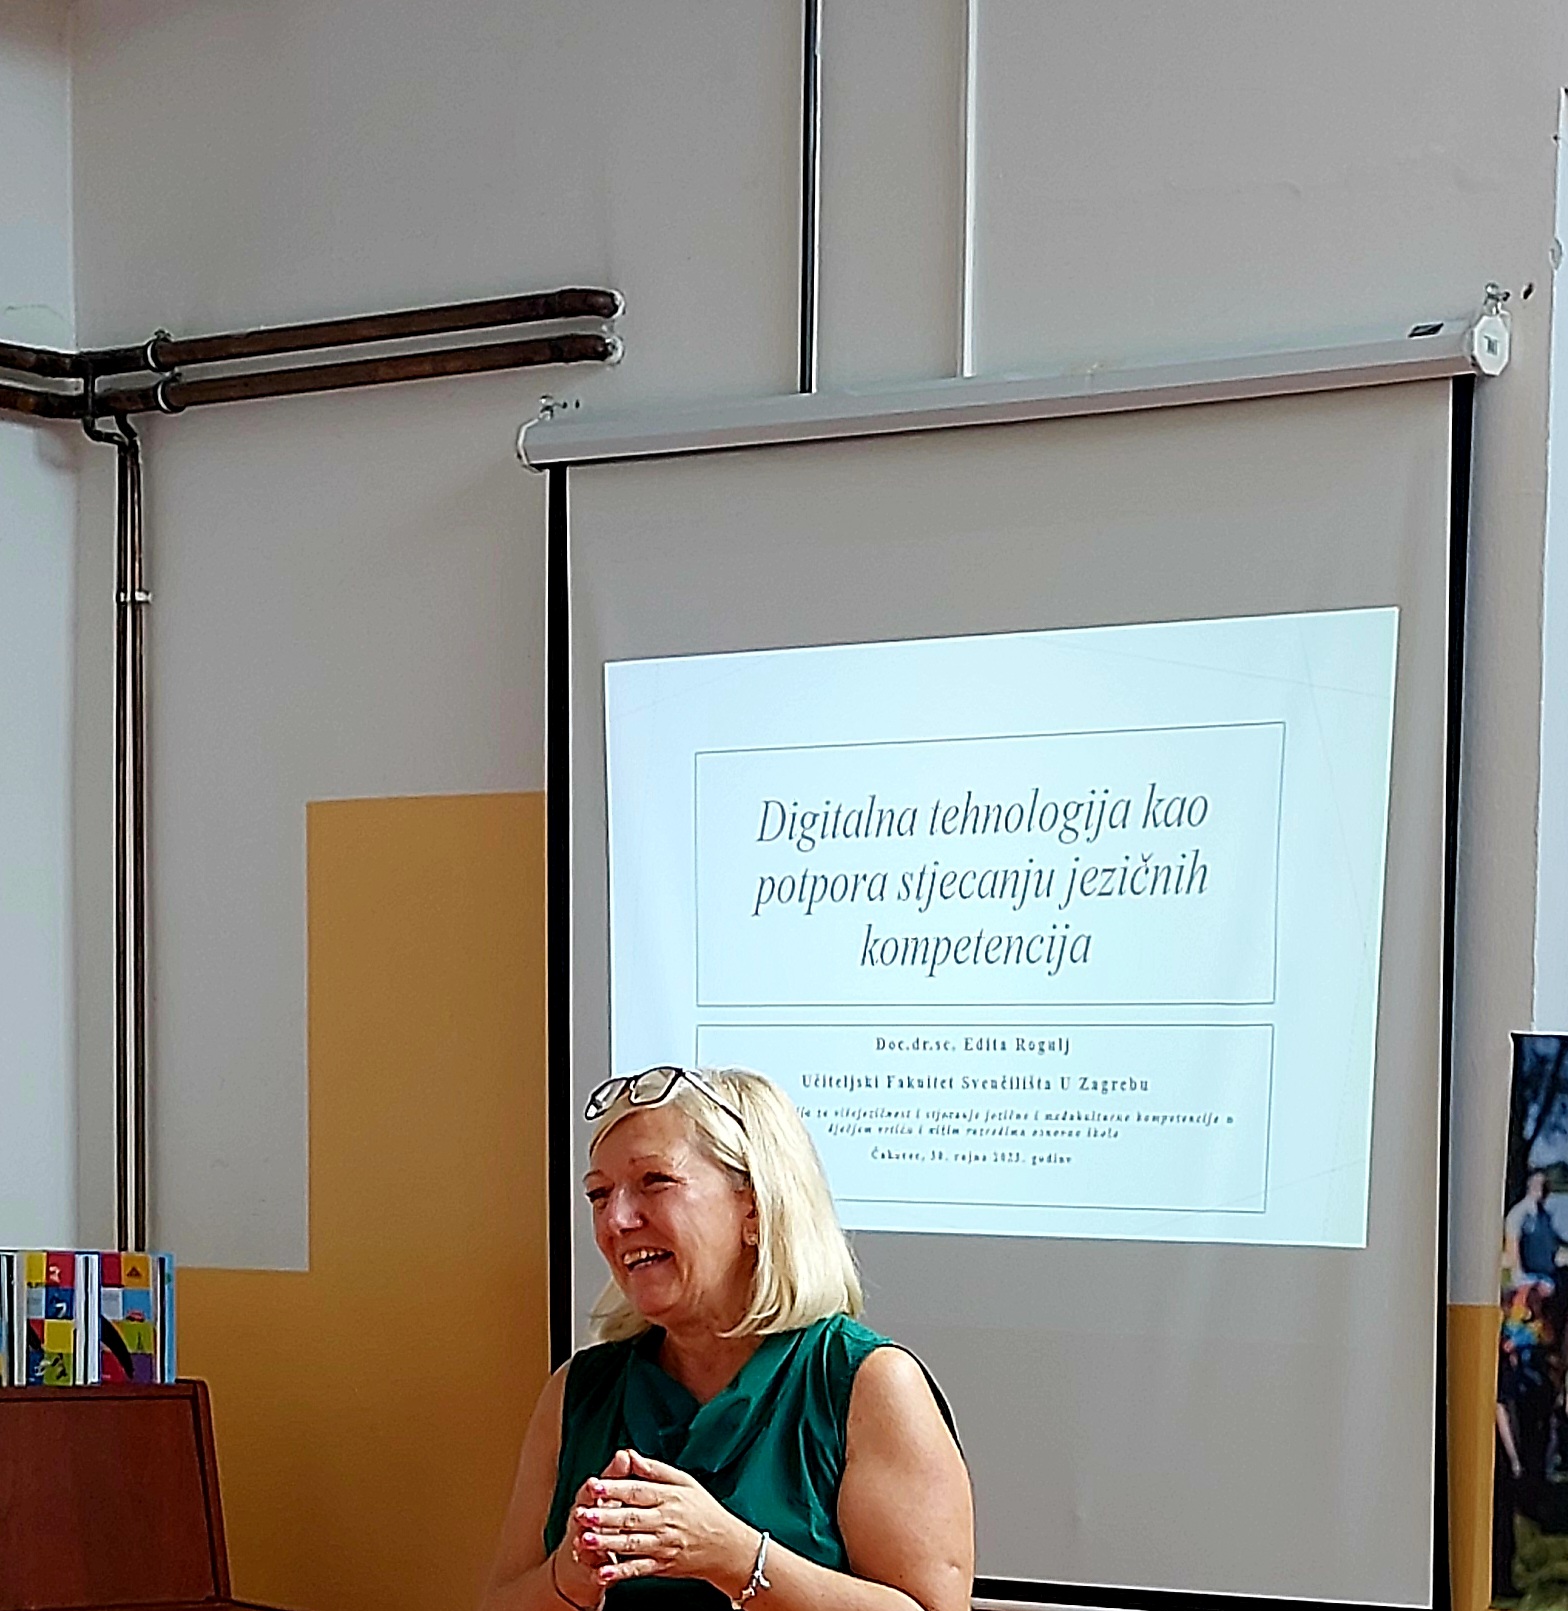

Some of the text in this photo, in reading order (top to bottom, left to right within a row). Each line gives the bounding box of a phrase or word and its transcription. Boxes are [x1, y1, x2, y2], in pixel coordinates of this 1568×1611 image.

[756, 782, 1209, 853] Digitalna tehnologija kao
[751, 848, 1208, 918] potpora stjecanju jezičnih
[860, 923, 1092, 978] kompetencija
[876, 1036, 1070, 1056] Doc.dr.sc. Edita Rogulj
[802, 1073, 1149, 1095] Učiteljski Fakultet Sveučilišta U Zagrebu
